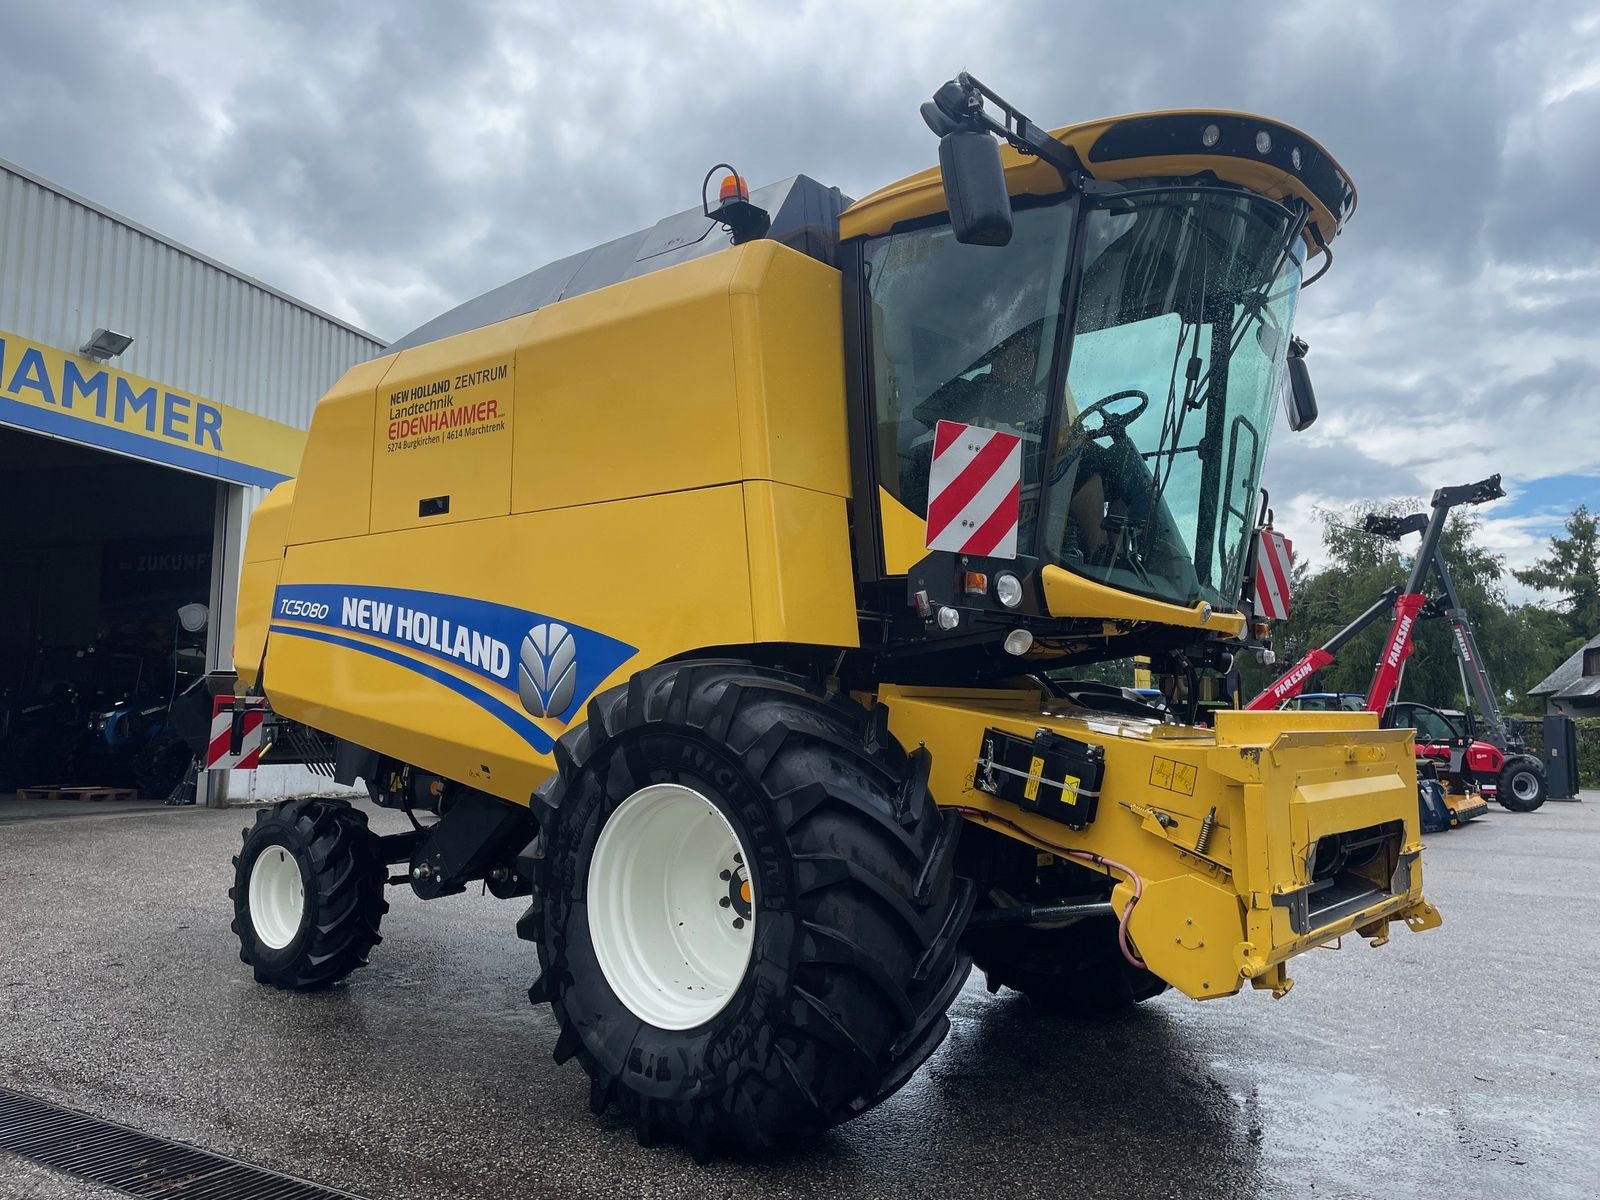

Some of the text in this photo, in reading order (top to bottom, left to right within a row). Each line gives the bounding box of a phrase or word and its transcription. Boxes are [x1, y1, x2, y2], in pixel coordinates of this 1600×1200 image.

[0, 338, 224, 451] AMMER
[390, 365, 508, 406] NEW HOLLAND ZENTRUM
[388, 399, 498, 440] EIDENHAMMER
[389, 395, 454, 421] Landtechnik
[387, 442, 402, 453] 5274
[403, 434, 440, 450] Burgkirchen
[446, 429, 463, 440] 4614
[464, 420, 505, 437] Marchtrenk
[279, 598, 329, 620] TC5080
[341, 596, 511, 680] NEW HOLLAND
[1387, 614, 1413, 668] FARESIN
[1454, 627, 1471, 662] FARESIN
[1274, 662, 1313, 698] FARESIN
